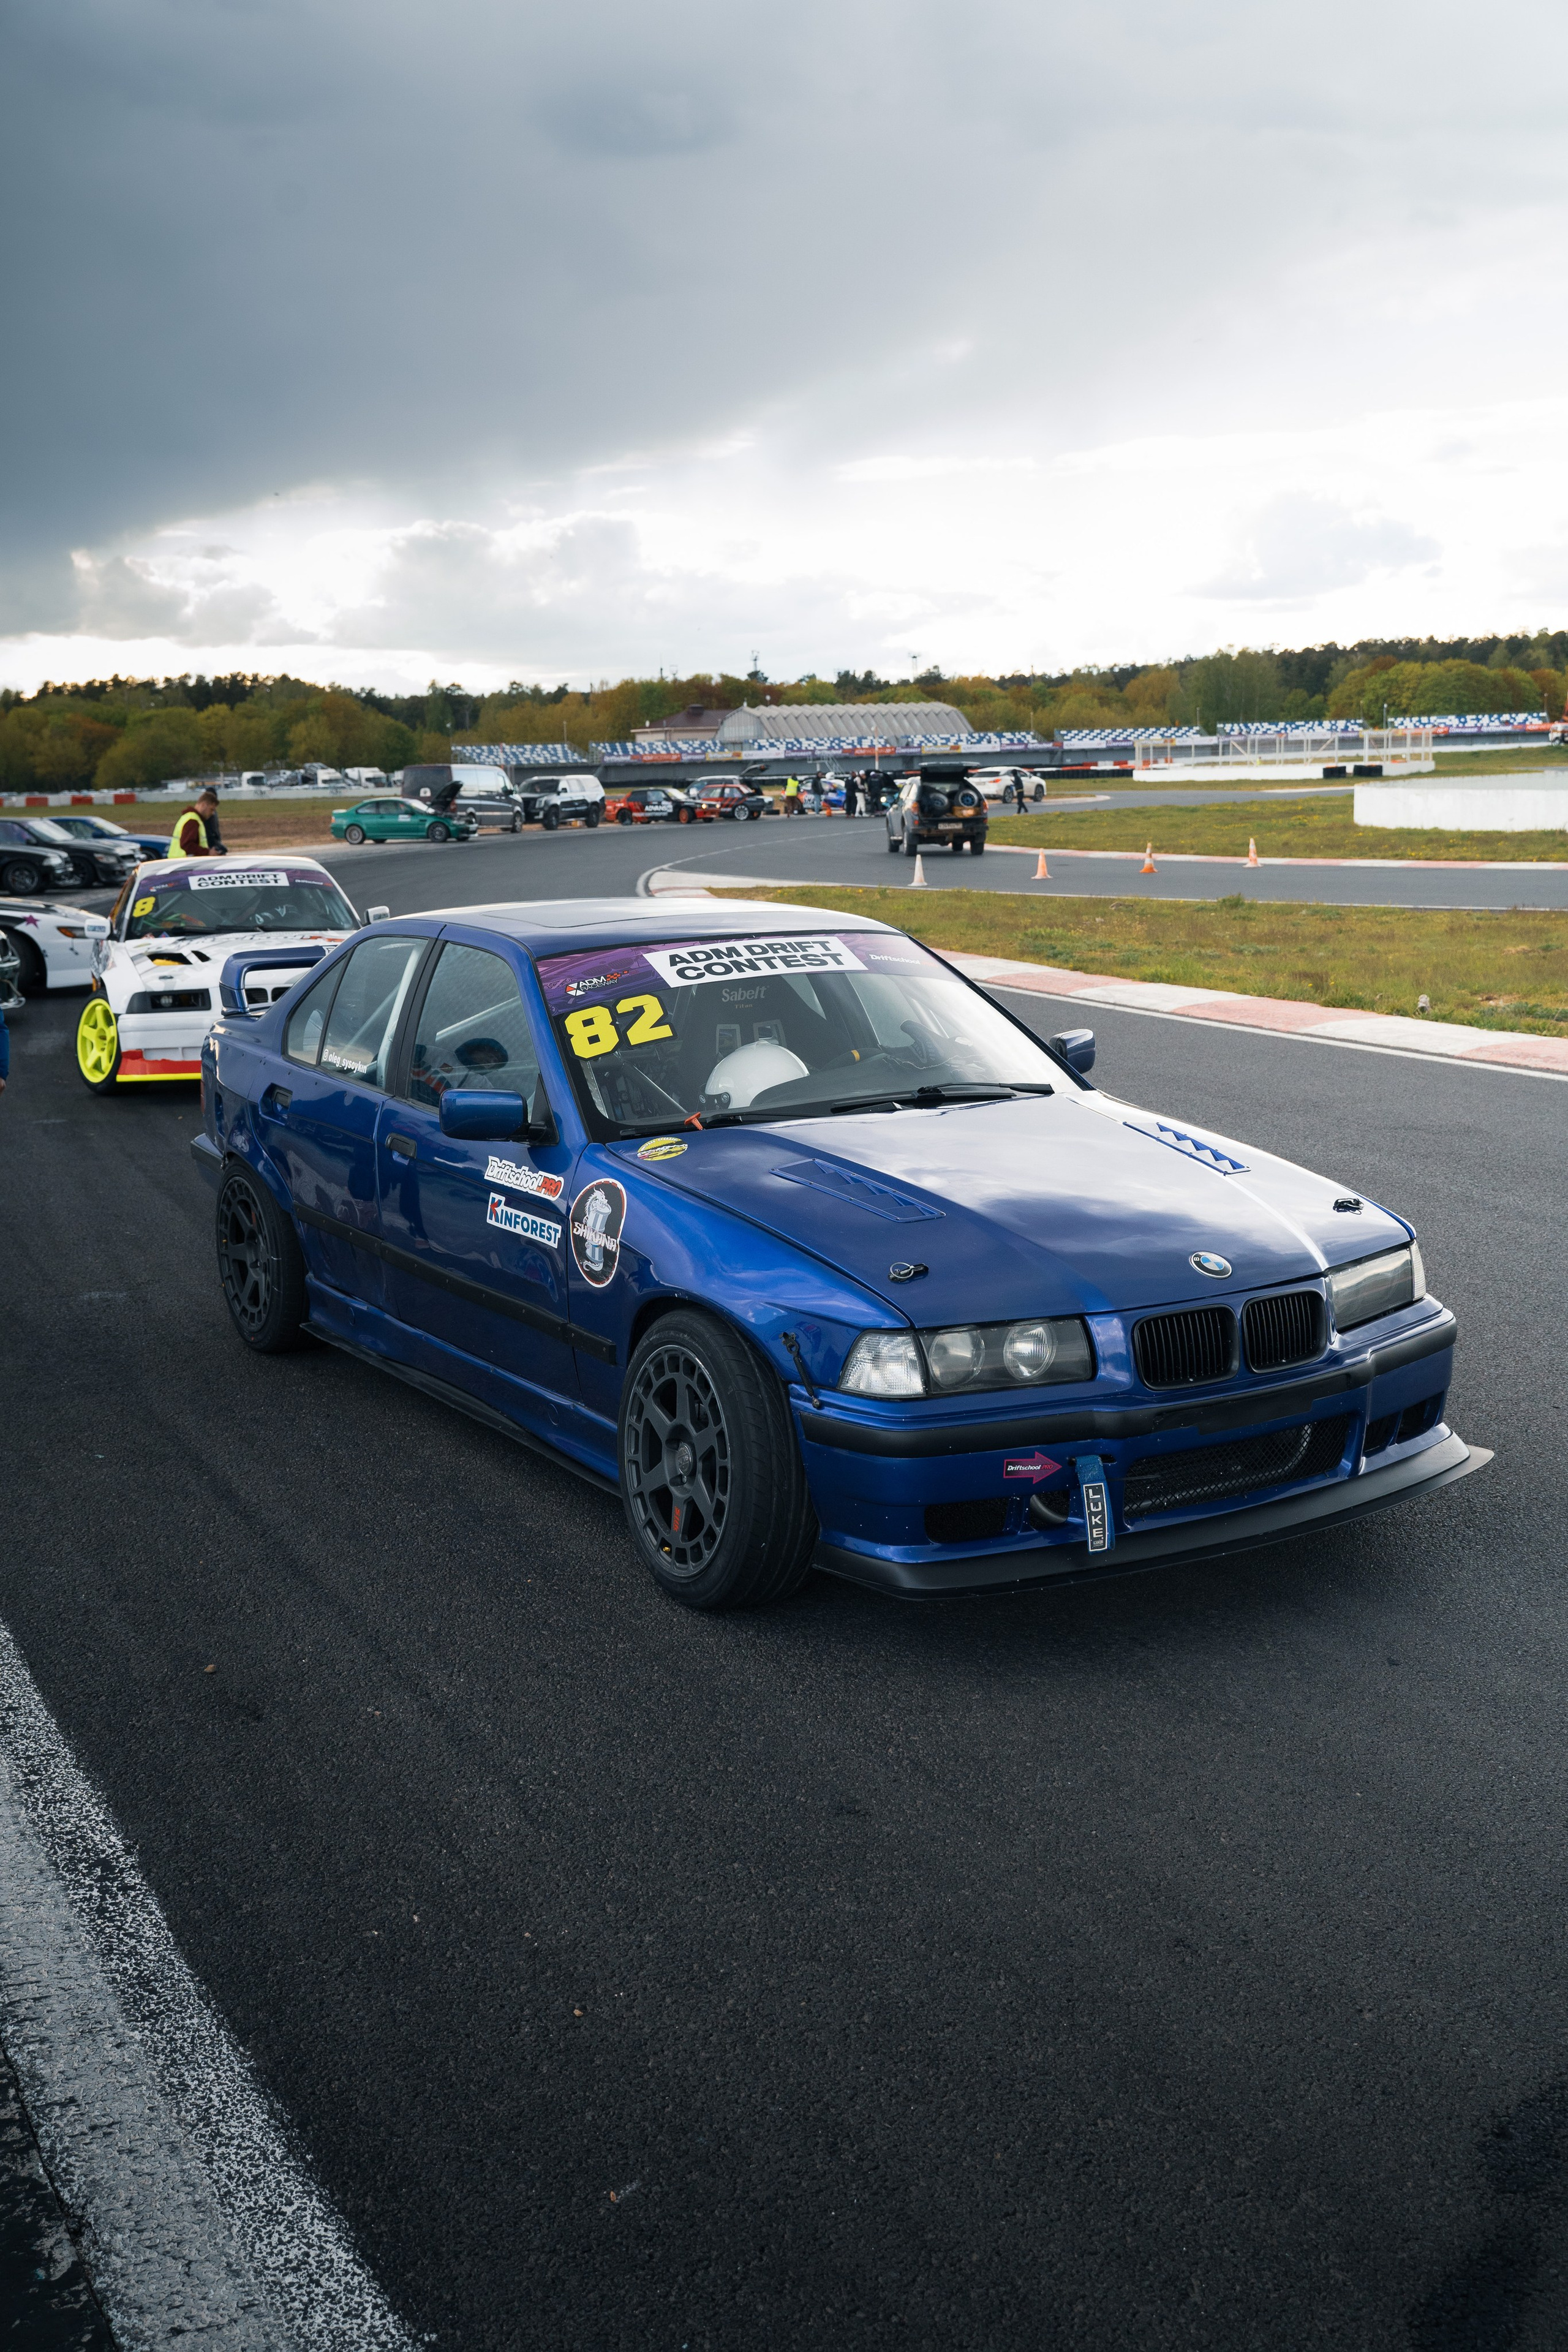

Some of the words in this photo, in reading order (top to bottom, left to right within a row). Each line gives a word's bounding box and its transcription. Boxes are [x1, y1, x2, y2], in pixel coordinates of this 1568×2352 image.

[197, 878, 281, 887] CONTEST
[132, 896, 156, 918] 8
[669, 946, 739, 967] ADM
[743, 941, 833, 956] DRIFT
[676, 953, 845, 980] CONTEST
[579, 976, 607, 988] ADM
[581, 979, 618, 991] RACEWAY
[722, 986, 767, 1002] Sabelt
[564, 994, 673, 1059] 82
[489, 1196, 559, 1245] KINFOREST
[1088, 1488, 1104, 1538] LUKE
